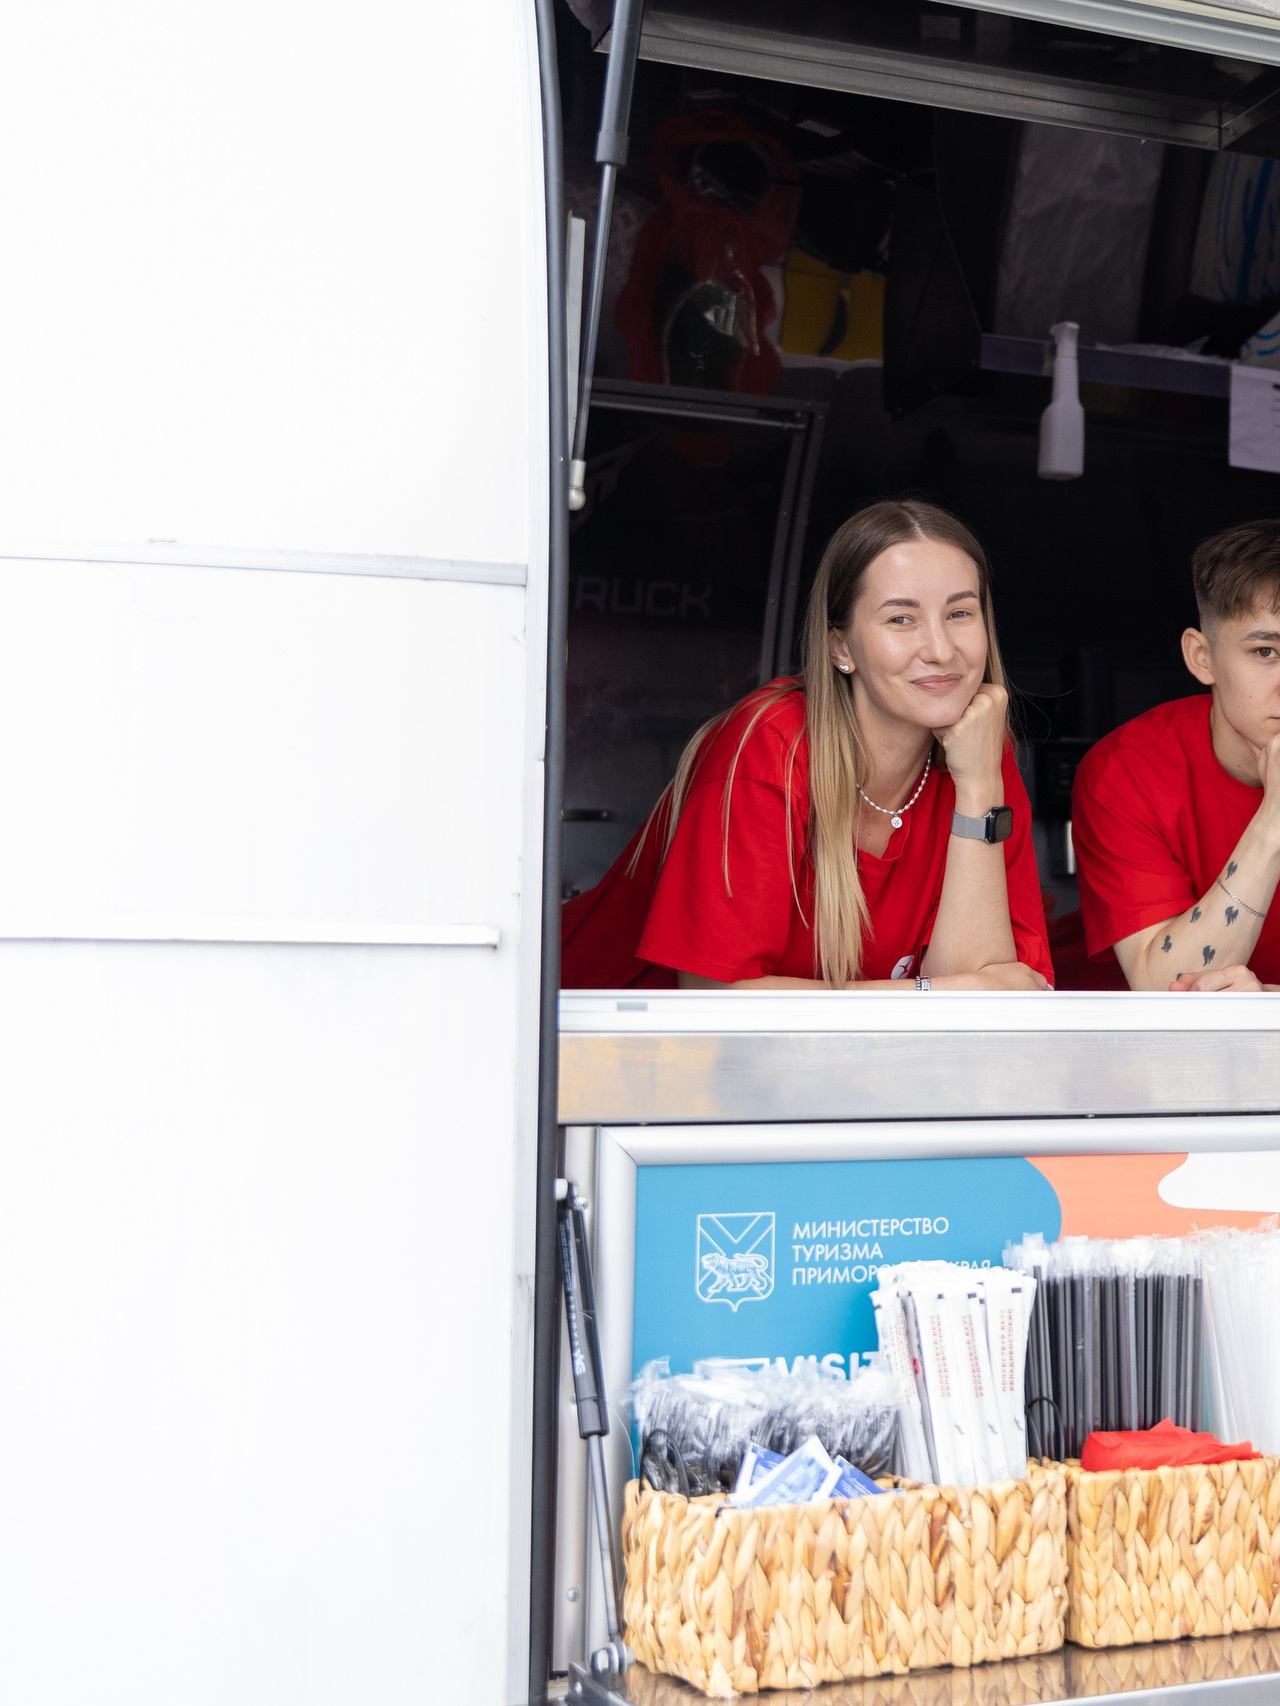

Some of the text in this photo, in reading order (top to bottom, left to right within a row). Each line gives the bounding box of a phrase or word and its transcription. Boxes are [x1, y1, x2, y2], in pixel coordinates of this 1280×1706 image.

[570, 576, 713, 619] RUCK
[793, 1216, 950, 1240] МИНИСТЕРСТВО
[792, 1242, 884, 1263] ТУРИЗМА
[793, 1264, 897, 1285] ПРИМОР
